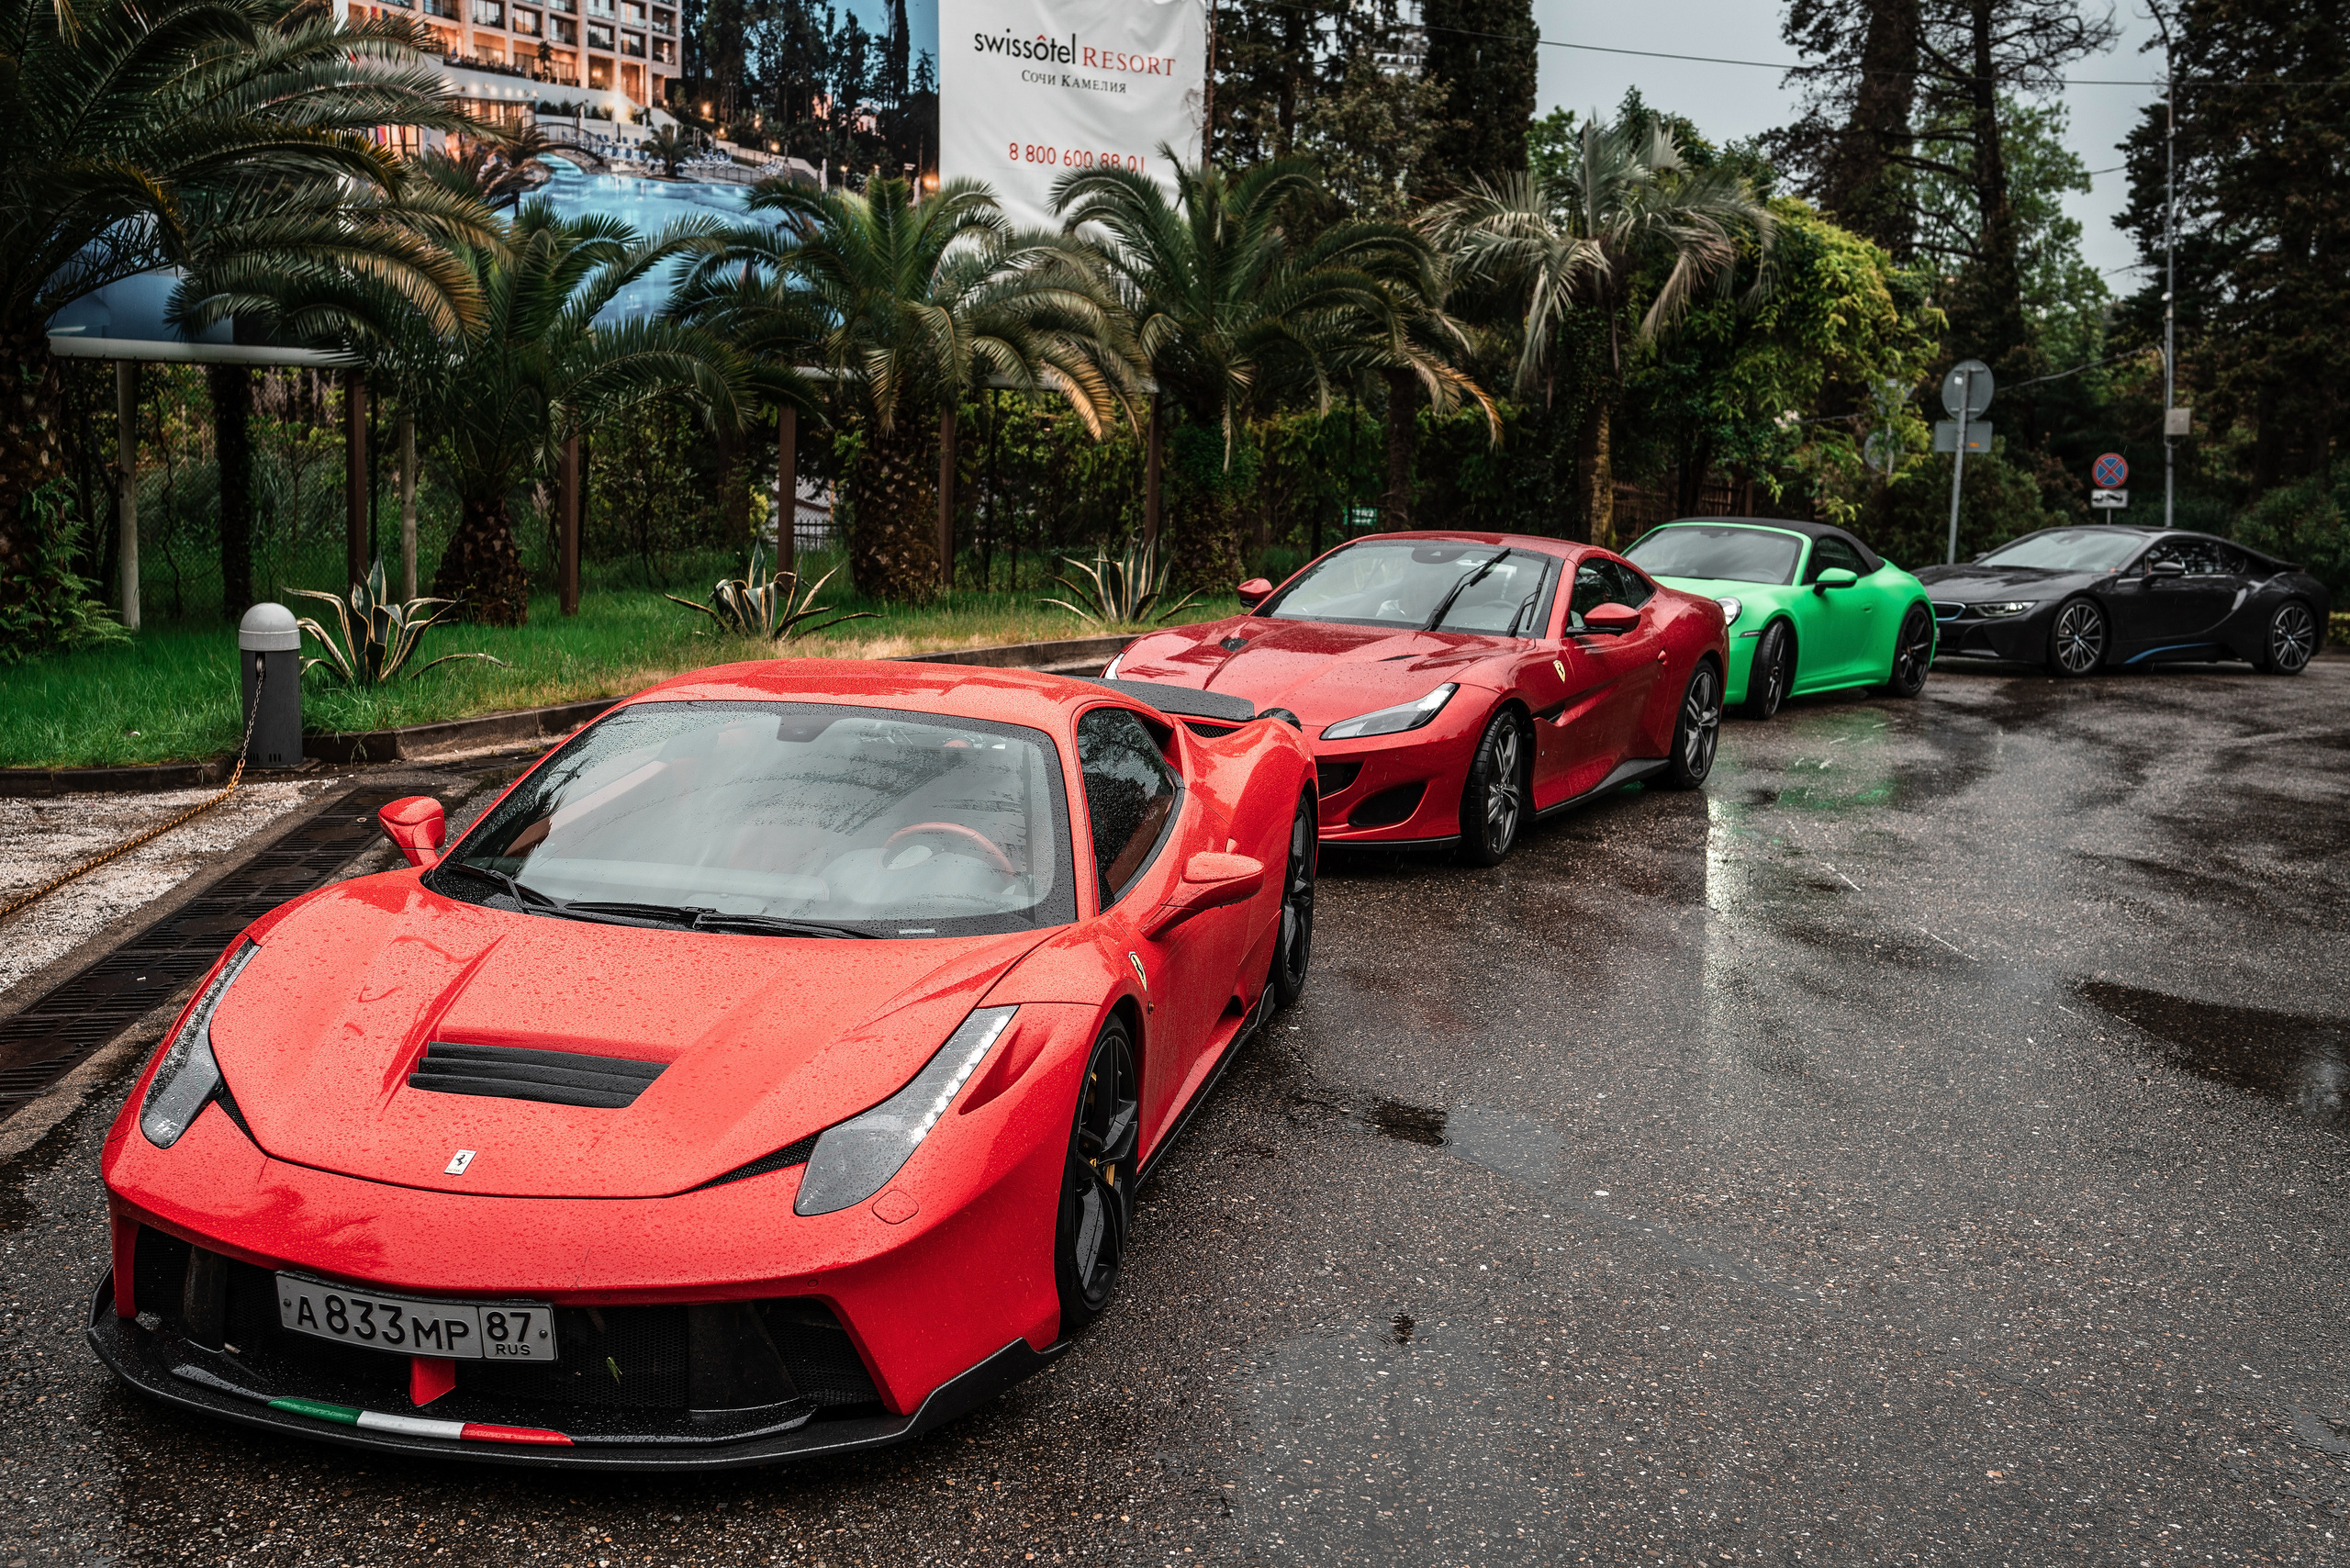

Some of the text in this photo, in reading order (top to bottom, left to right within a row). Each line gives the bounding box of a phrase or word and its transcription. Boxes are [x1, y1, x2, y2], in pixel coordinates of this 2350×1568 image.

[974, 28, 1176, 76] swissôtel RESORT
[1009, 142, 1145, 174] 8 800 600 88 01
[486, 1311, 532, 1343] 87
[496, 1343, 532, 1356] RUS
